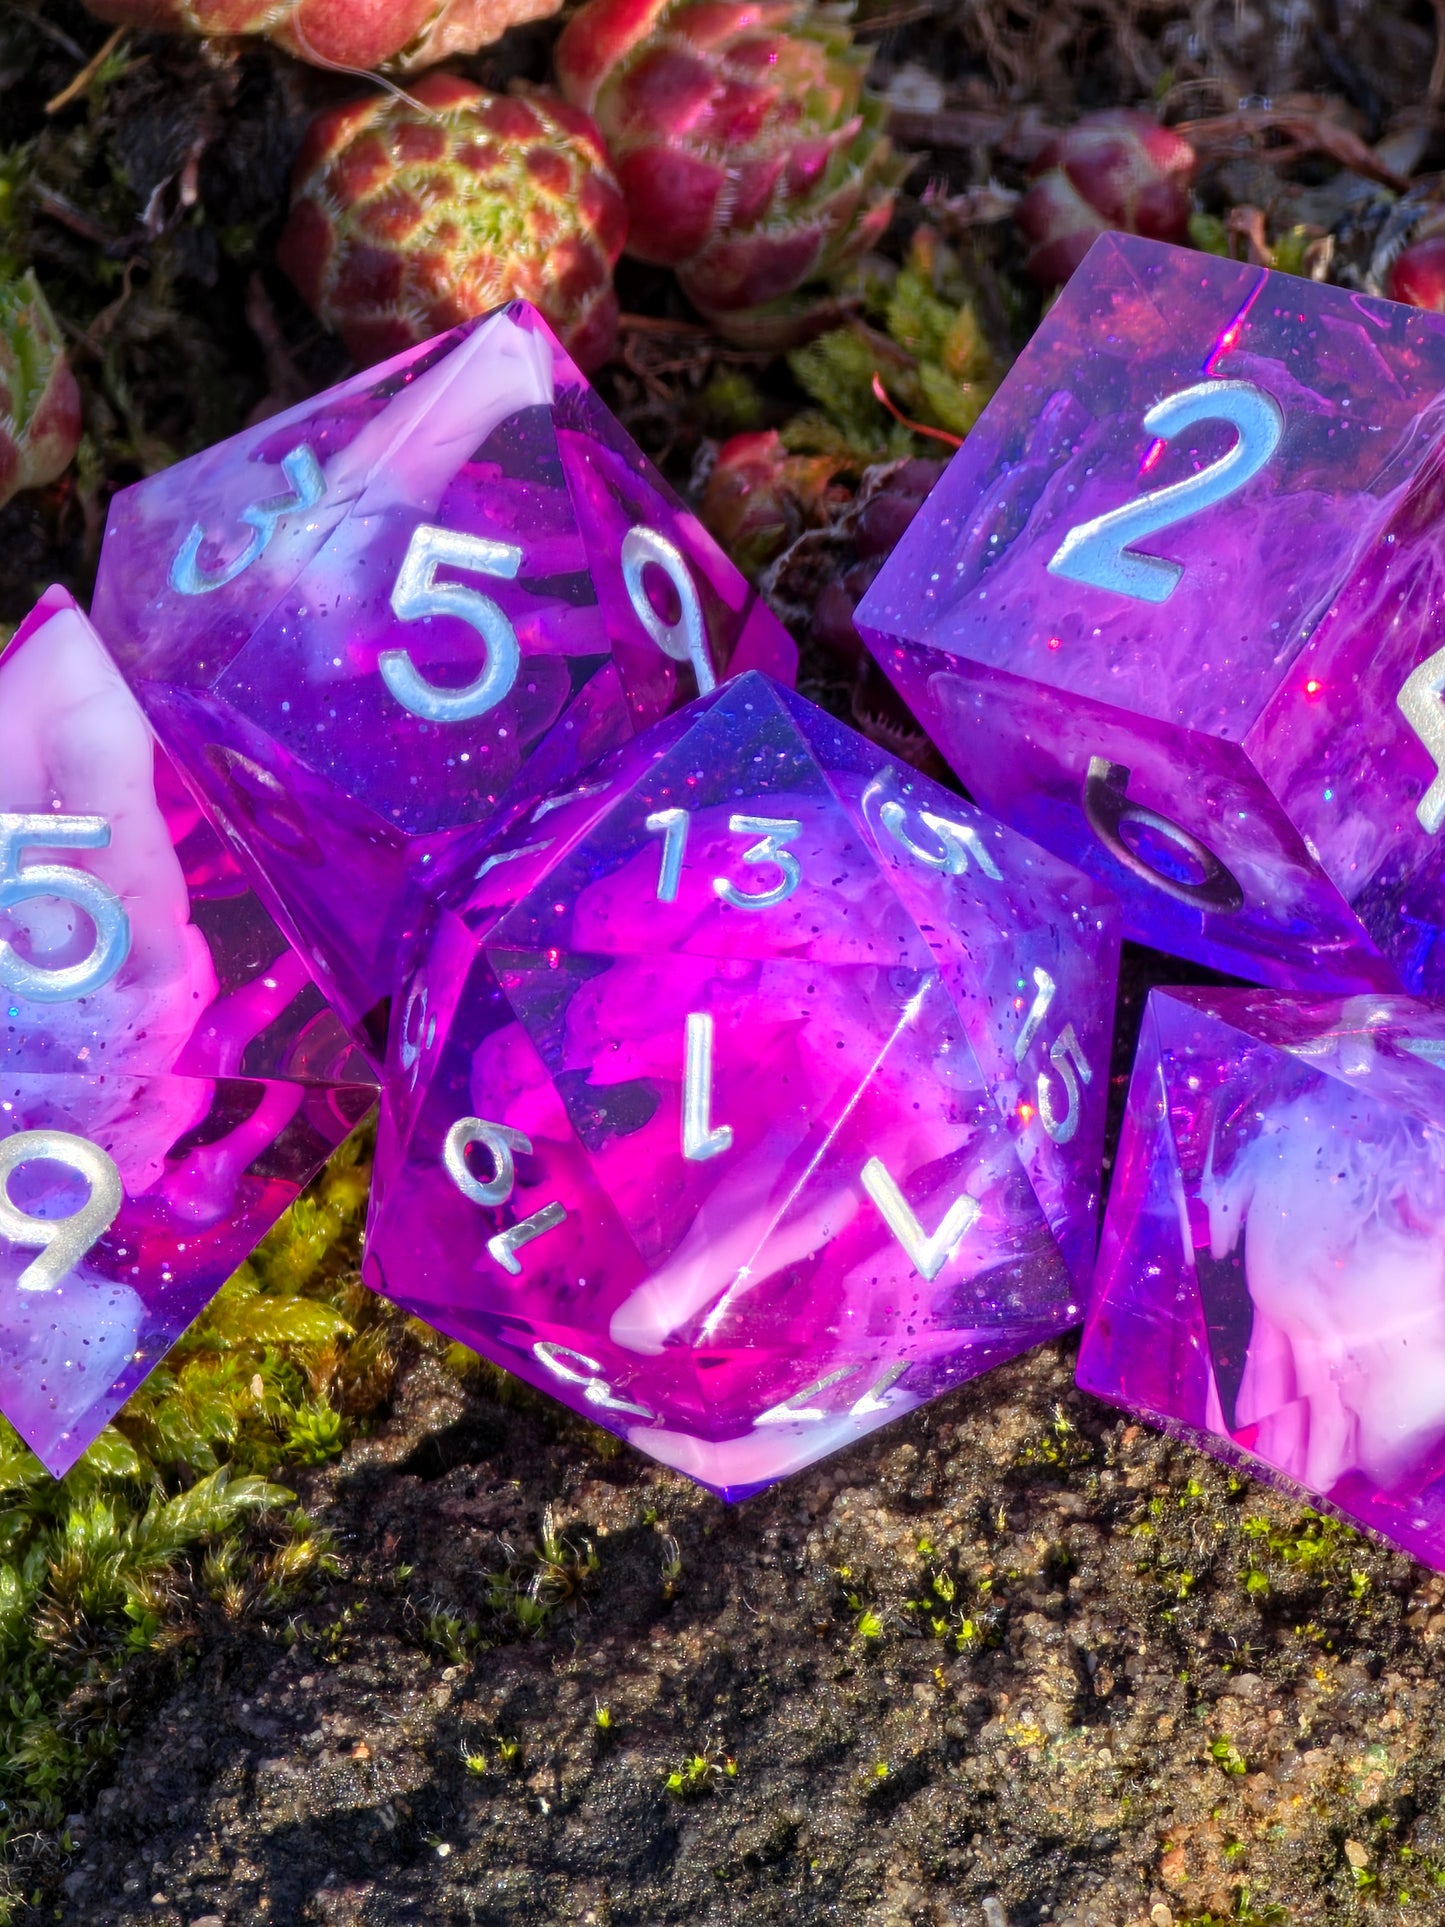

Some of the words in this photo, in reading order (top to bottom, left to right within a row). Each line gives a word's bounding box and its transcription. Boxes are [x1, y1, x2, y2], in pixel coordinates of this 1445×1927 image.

[170, 444, 327, 595] 3
[1047, 380, 1284, 604] 2
[378, 524, 523, 721] 5
[621, 525, 716, 696] 9
[0, 813, 131, 1002] 5
[646, 808, 801, 909] 13
[1083, 755, 1244, 915] 6
[681, 1012, 732, 1160] 1
[1014, 966, 1092, 1144] 15
[0, 1130, 122, 1292] 9
[860, 1155, 980, 1282] 7
